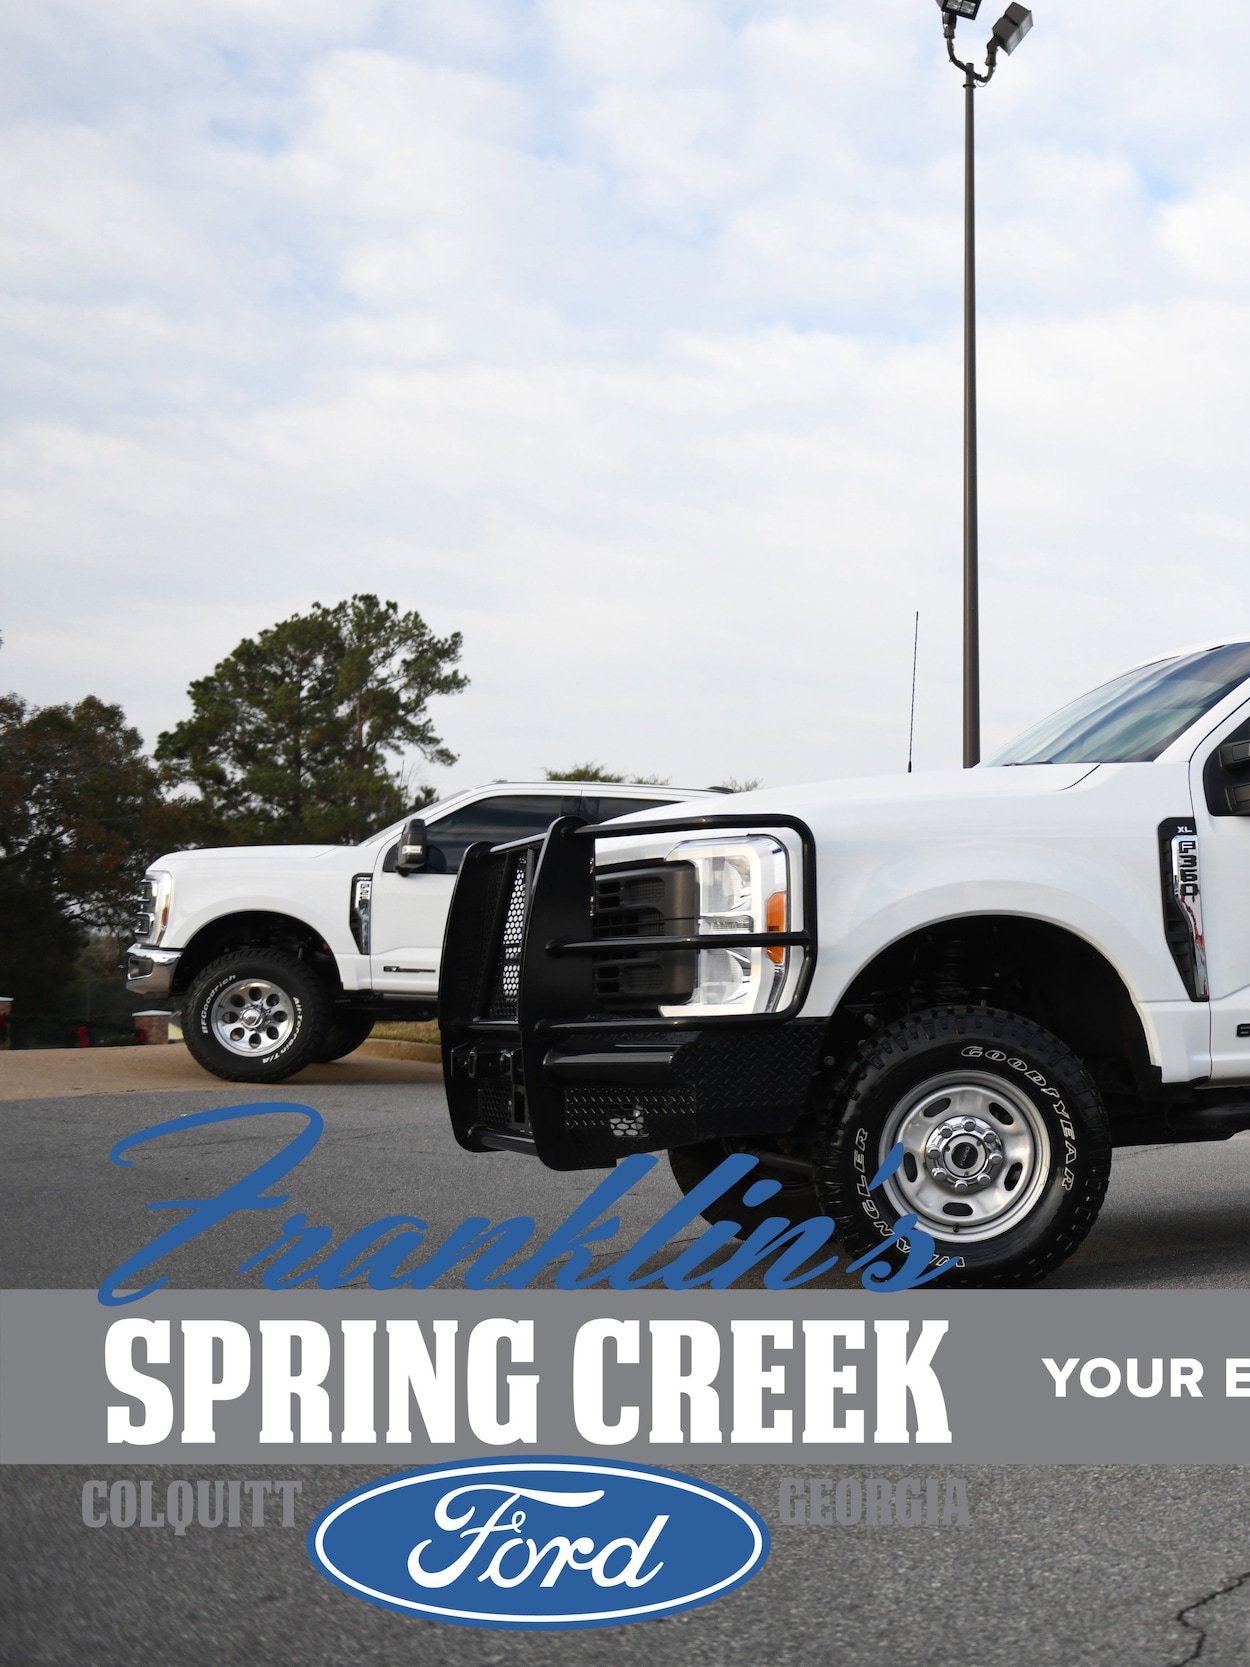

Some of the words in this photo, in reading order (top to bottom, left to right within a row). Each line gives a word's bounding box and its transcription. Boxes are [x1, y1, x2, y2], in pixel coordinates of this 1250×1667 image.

[1177, 825, 1193, 833] XL
[200, 974, 236, 1034] BFGoodrich
[960, 1045, 1077, 1191] GOODYEAR
